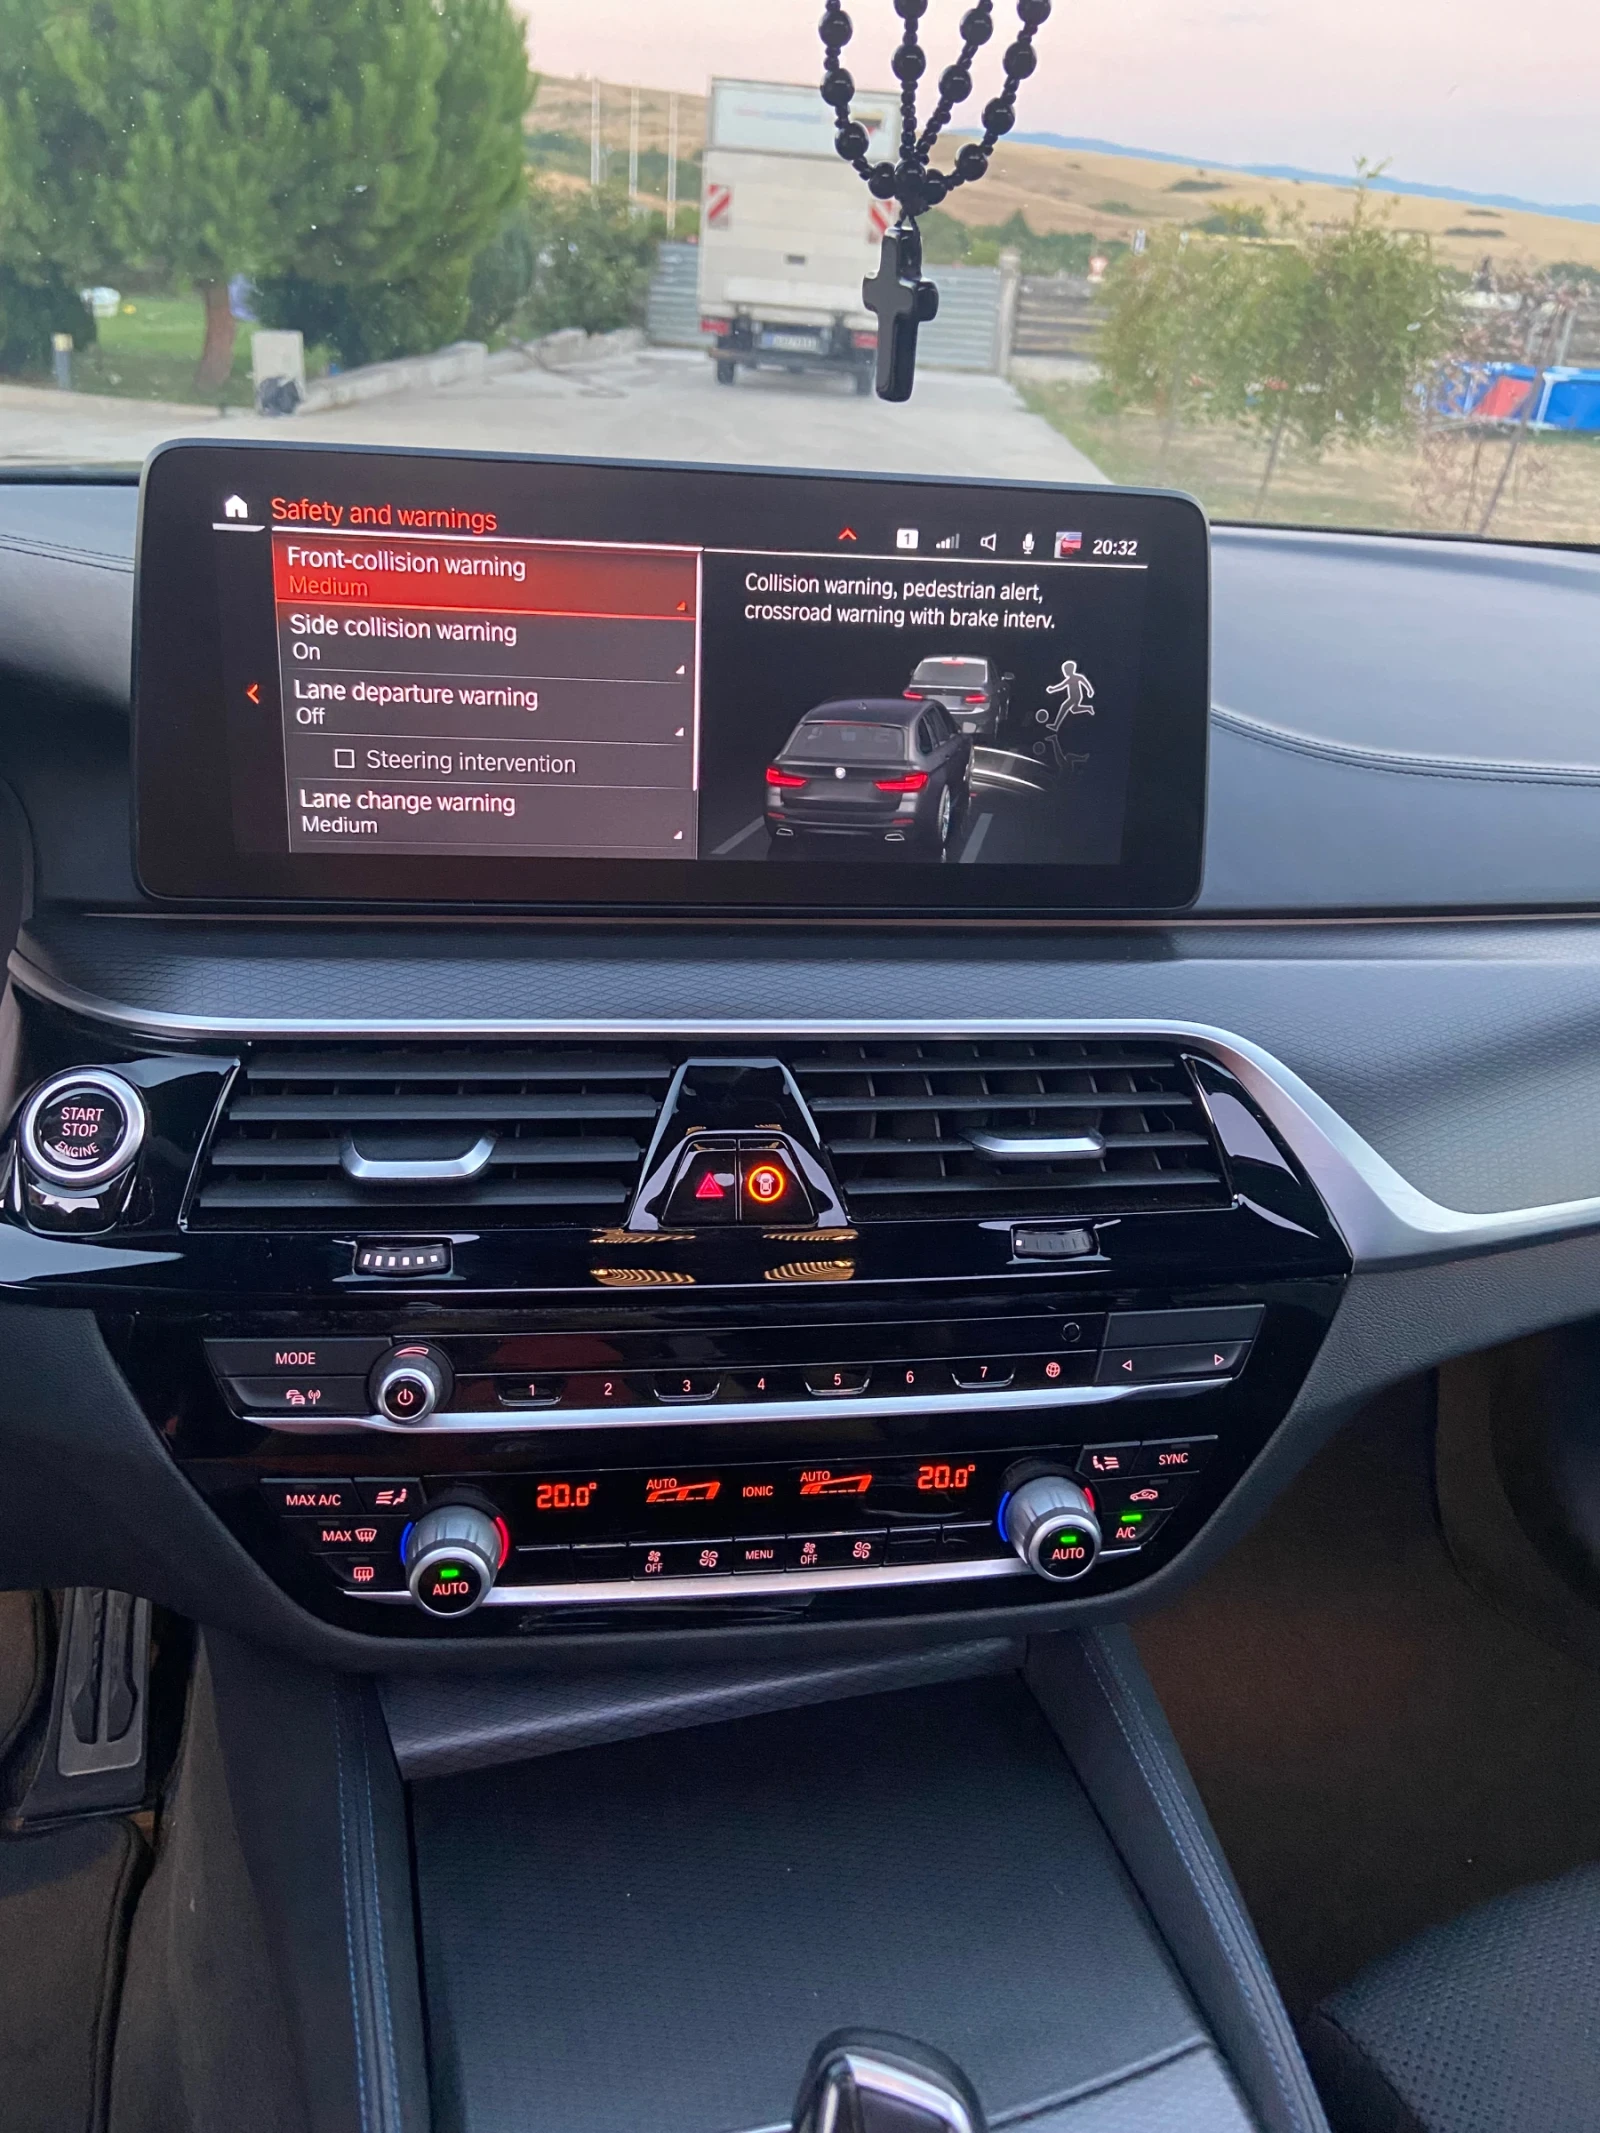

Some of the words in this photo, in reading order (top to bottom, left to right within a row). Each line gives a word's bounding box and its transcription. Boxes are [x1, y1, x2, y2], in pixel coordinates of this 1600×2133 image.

[271, 497, 343, 525] Safety
[350, 504, 392, 525] and
[398, 508, 498, 532] warnings
[1092, 539, 1138, 556] 20:32
[287, 546, 439, 573] Front-collision
[444, 555, 526, 581] warning
[289, 574, 368, 597] Medium
[745, 572, 820, 594] Collision
[824, 577, 898, 600] warning,
[902, 580, 996, 601] pedestrian
[999, 583, 1043, 603] alert,
[744, 603, 832, 623] crossroad
[836, 606, 905, 628] warning
[909, 607, 945, 626] with
[949, 608, 999, 628] brake
[1003, 612, 1056, 630] interv.
[289, 613, 339, 636] Side
[344, 616, 431, 639] collision
[435, 621, 517, 646] warning
[292, 641, 321, 661] On
[294, 679, 347, 701] Lane
[351, 682, 454, 705] departure
[458, 687, 538, 711] warning
[296, 706, 326, 725] Off
[366, 749, 453, 775] Steering
[458, 752, 577, 774] intervention
[300, 788, 352, 809] Lane
[356, 790, 433, 815] change
[436, 793, 516, 817] warning
[301, 815, 378, 834] Medium
[60, 1106, 104, 1121] START
[61, 1123, 99, 1137] STOP
[55, 1140, 100, 1158] ENGINE
[275, 1351, 317, 1365] MODE
[833, 1372, 842, 1387] 5
[905, 1370, 915, 1384] 6
[980, 1366, 989, 1380] 7
[528, 1383, 536, 1397] 1
[604, 1382, 613, 1396] 2
[682, 1379, 692, 1393] 3
[757, 1377, 766, 1391] 4
[1158, 1452, 1189, 1466] SYNC
[645, 1477, 678, 1490] AUTO
[799, 1470, 831, 1483] AUTO
[742, 1485, 774, 1498] IONIC
[285, 1494, 316, 1506] MAX
[318, 1493, 342, 1507] A/C
[322, 1530, 352, 1542] MAX
[1115, 1526, 1137, 1540] A/C
[745, 1548, 774, 1561] MENU
[800, 1553, 818, 1566] OFF
[1051, 1545, 1085, 1561] AUTO
[644, 1561, 664, 1574] OFF
[432, 1581, 469, 1597] AUTO
